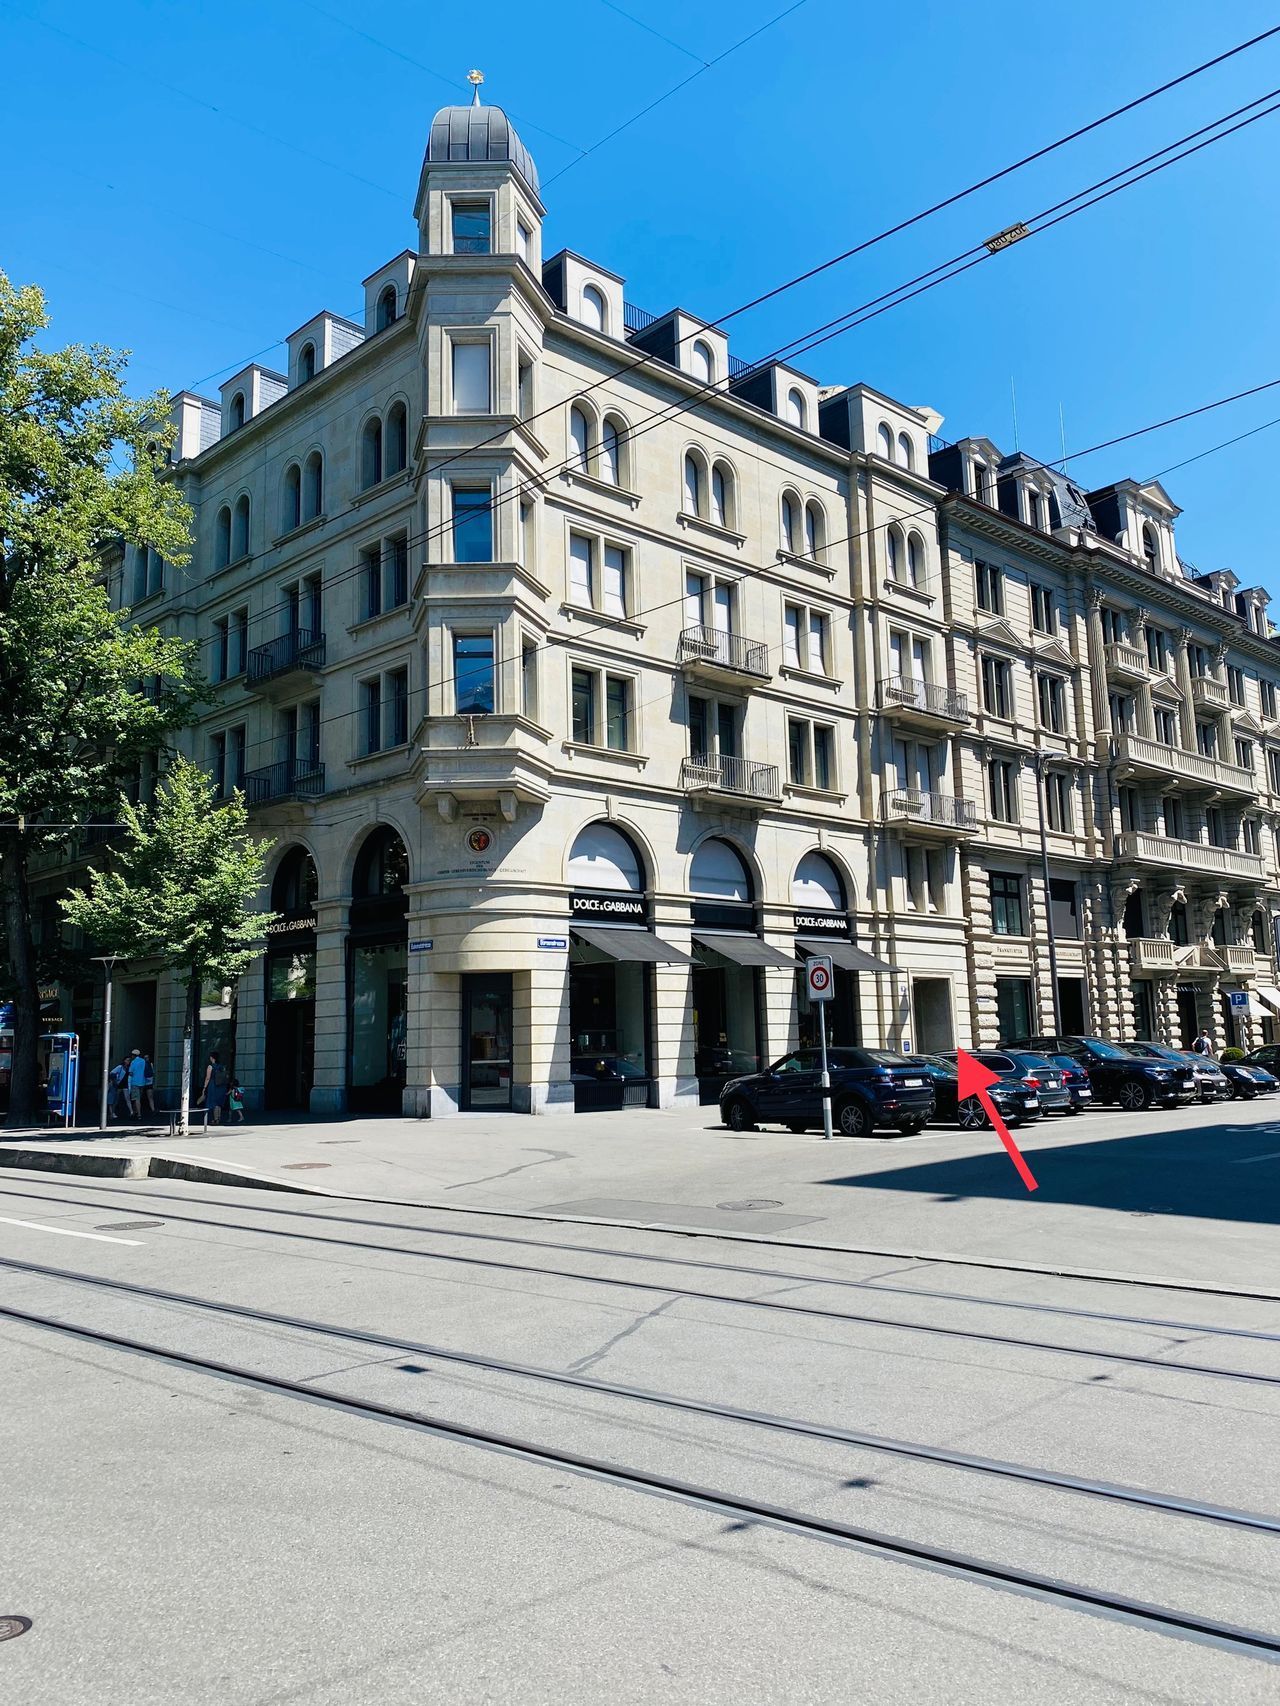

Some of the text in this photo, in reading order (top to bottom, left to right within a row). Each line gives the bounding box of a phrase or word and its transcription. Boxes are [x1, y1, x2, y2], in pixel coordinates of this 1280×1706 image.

[573, 898, 643, 914] DOLCE&GABBANA
[796, 916, 847, 929] DOLCE&GABBANA
[815, 973, 824, 983] 30
[1235, 994, 1242, 1004] P
